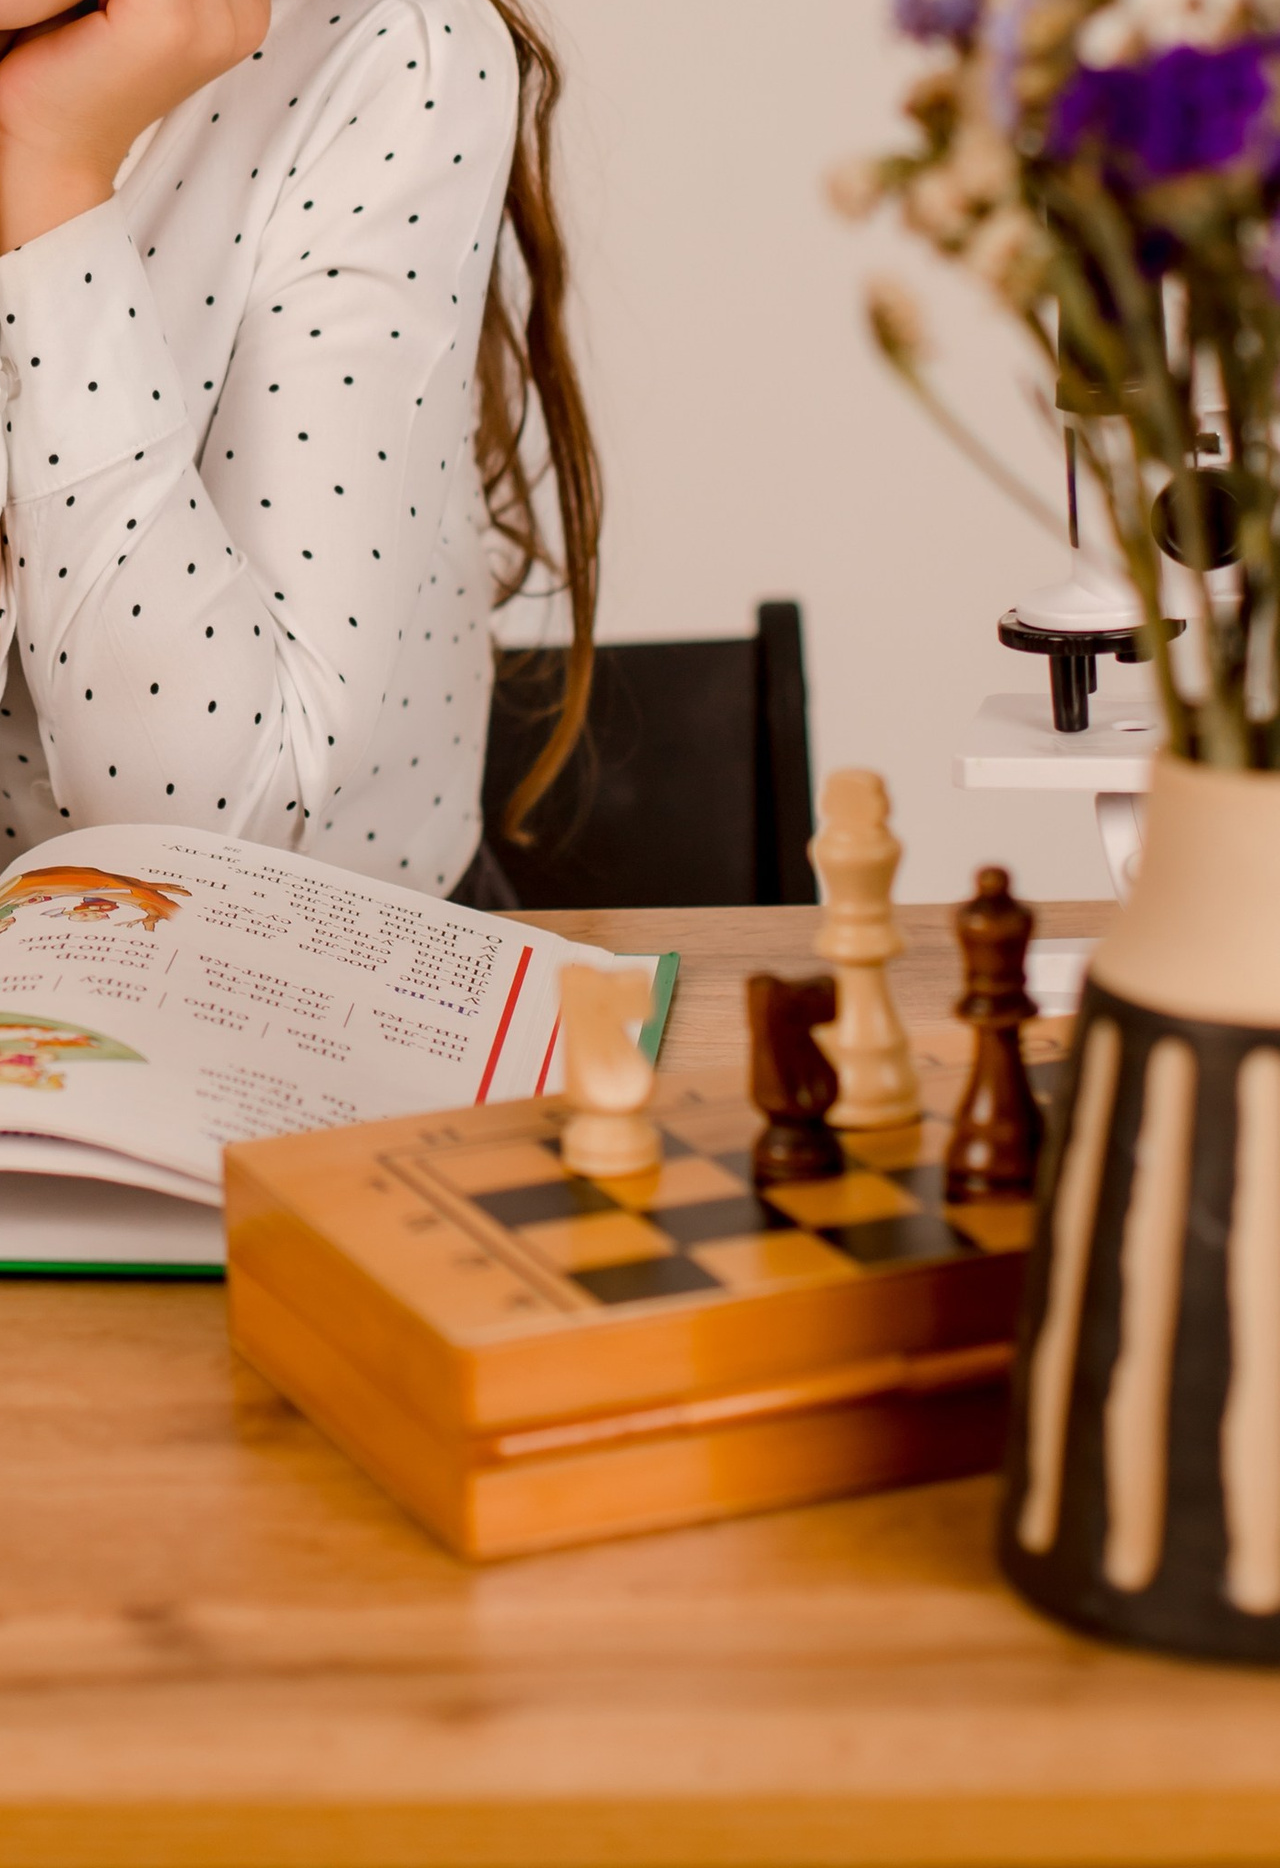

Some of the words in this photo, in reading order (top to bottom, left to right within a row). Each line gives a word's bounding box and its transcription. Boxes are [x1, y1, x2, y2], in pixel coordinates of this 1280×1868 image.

[140, 868, 230, 891] Па-ша.
[196, 914, 277, 940] ли-па.
[202, 907, 288, 934] ста-ра.
[218, 901, 292, 925] су-ха.
[288, 901, 355, 926] па-па
[377, 909, 458, 941] Па-ши
[296, 913, 395, 947] у-па-ла.
[313, 928, 391, 955] ста-ла
[382, 920, 455, 948] па-пы
[445, 922, 503, 944] О-ни
[26, 942, 155, 960] то-по-ры
[54, 952, 150, 970] то-пор
[297, 943, 377, 972] рос-ла
[310, 937, 388, 964] ста-ла
[377, 928, 493, 970] При-шли
[198, 954, 336, 1001] ло-пат-ка
[413, 958, 489, 987] Ли-па
[416, 949, 492, 978] Ли-па
[203, 968, 332, 1011] ло-па-ты
[398, 975, 440, 991] нас
[410, 967, 486, 996] Ли-па
[207, 980, 327, 1021] ло-па-та
[385, 983, 479, 1017] Ли-па.
[464, 996, 481, 1006] У
[286, 1028, 351, 1052] спра
[372, 1009, 469, 1043] пил-ка
[379, 1022, 467, 1052] пи-лы
[296, 1042, 347, 1063] пра
[383, 1034, 463, 1062] пи-ла
